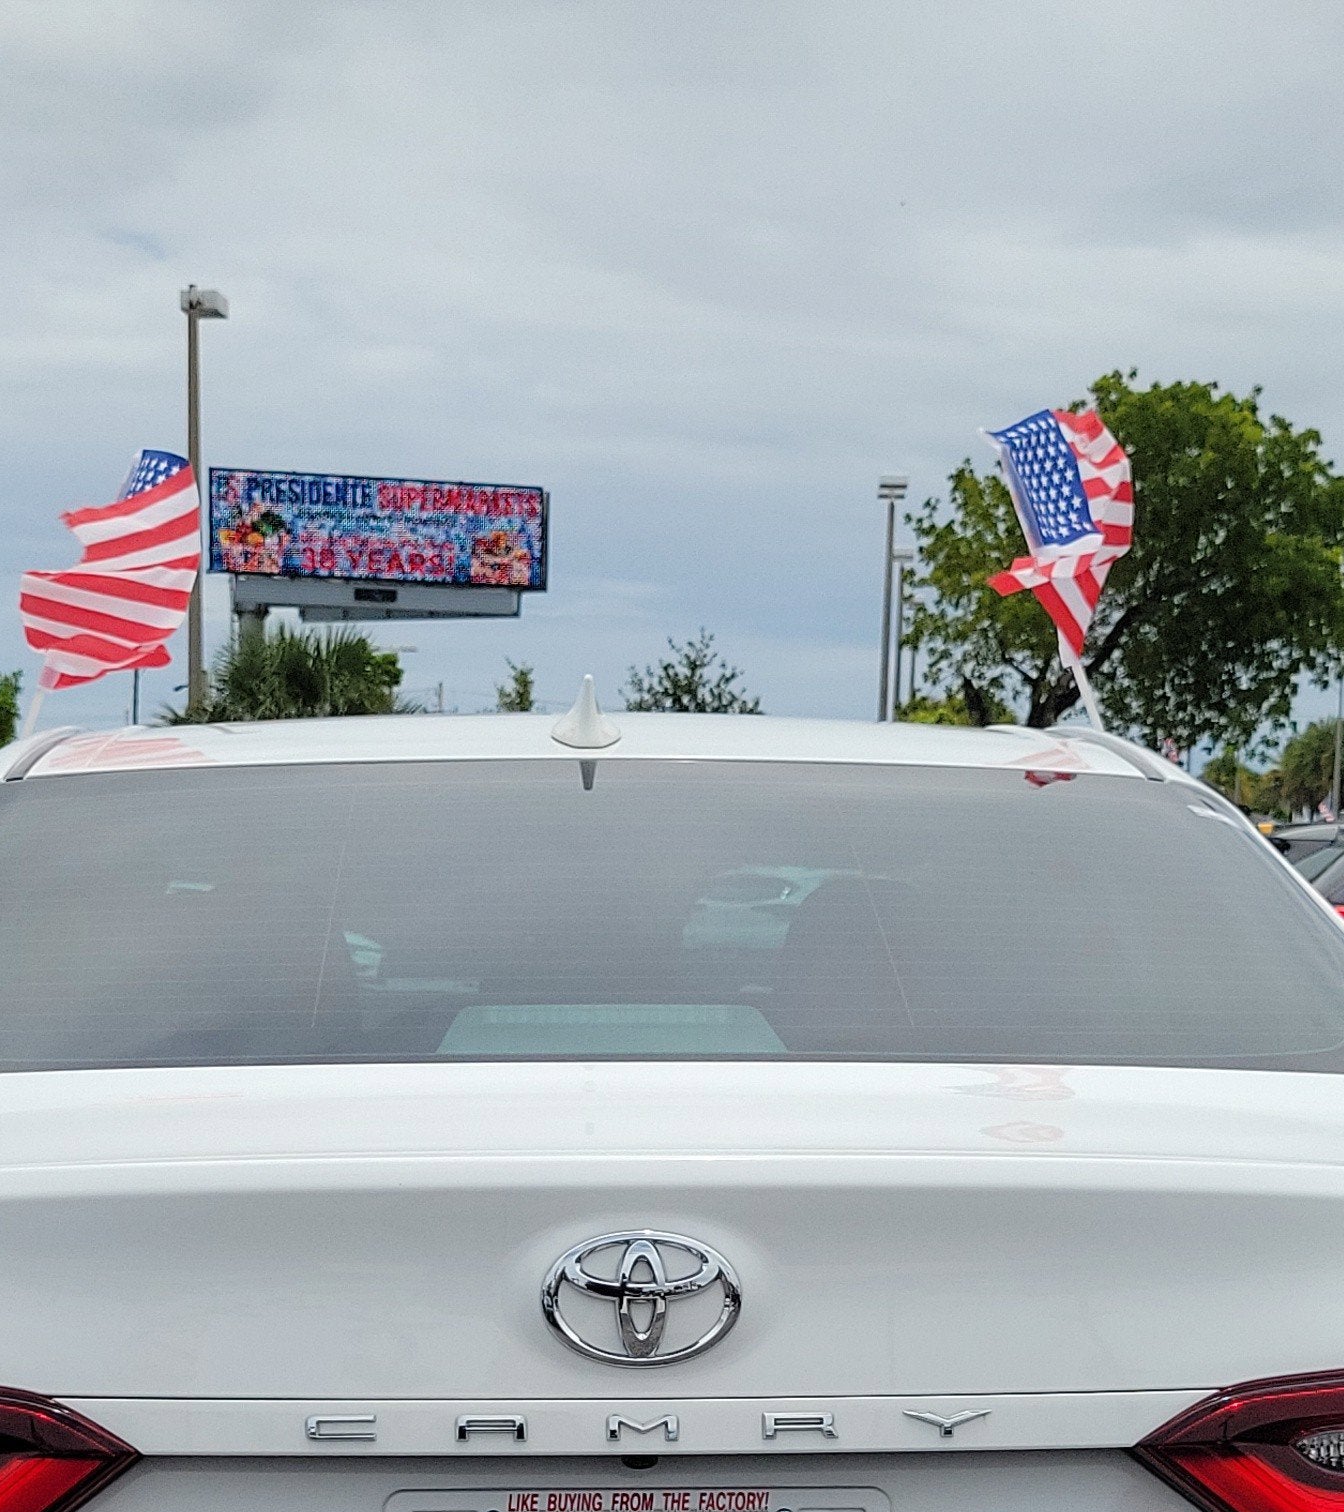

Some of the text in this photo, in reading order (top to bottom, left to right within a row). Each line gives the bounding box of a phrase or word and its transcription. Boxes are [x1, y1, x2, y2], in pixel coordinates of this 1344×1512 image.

[243, 477, 374, 508] PRESIDENTE
[304, 1408, 993, 1442] CAMRY
[508, 1491, 770, 1512] LIKE BUYING FROM THE FACTORY!
